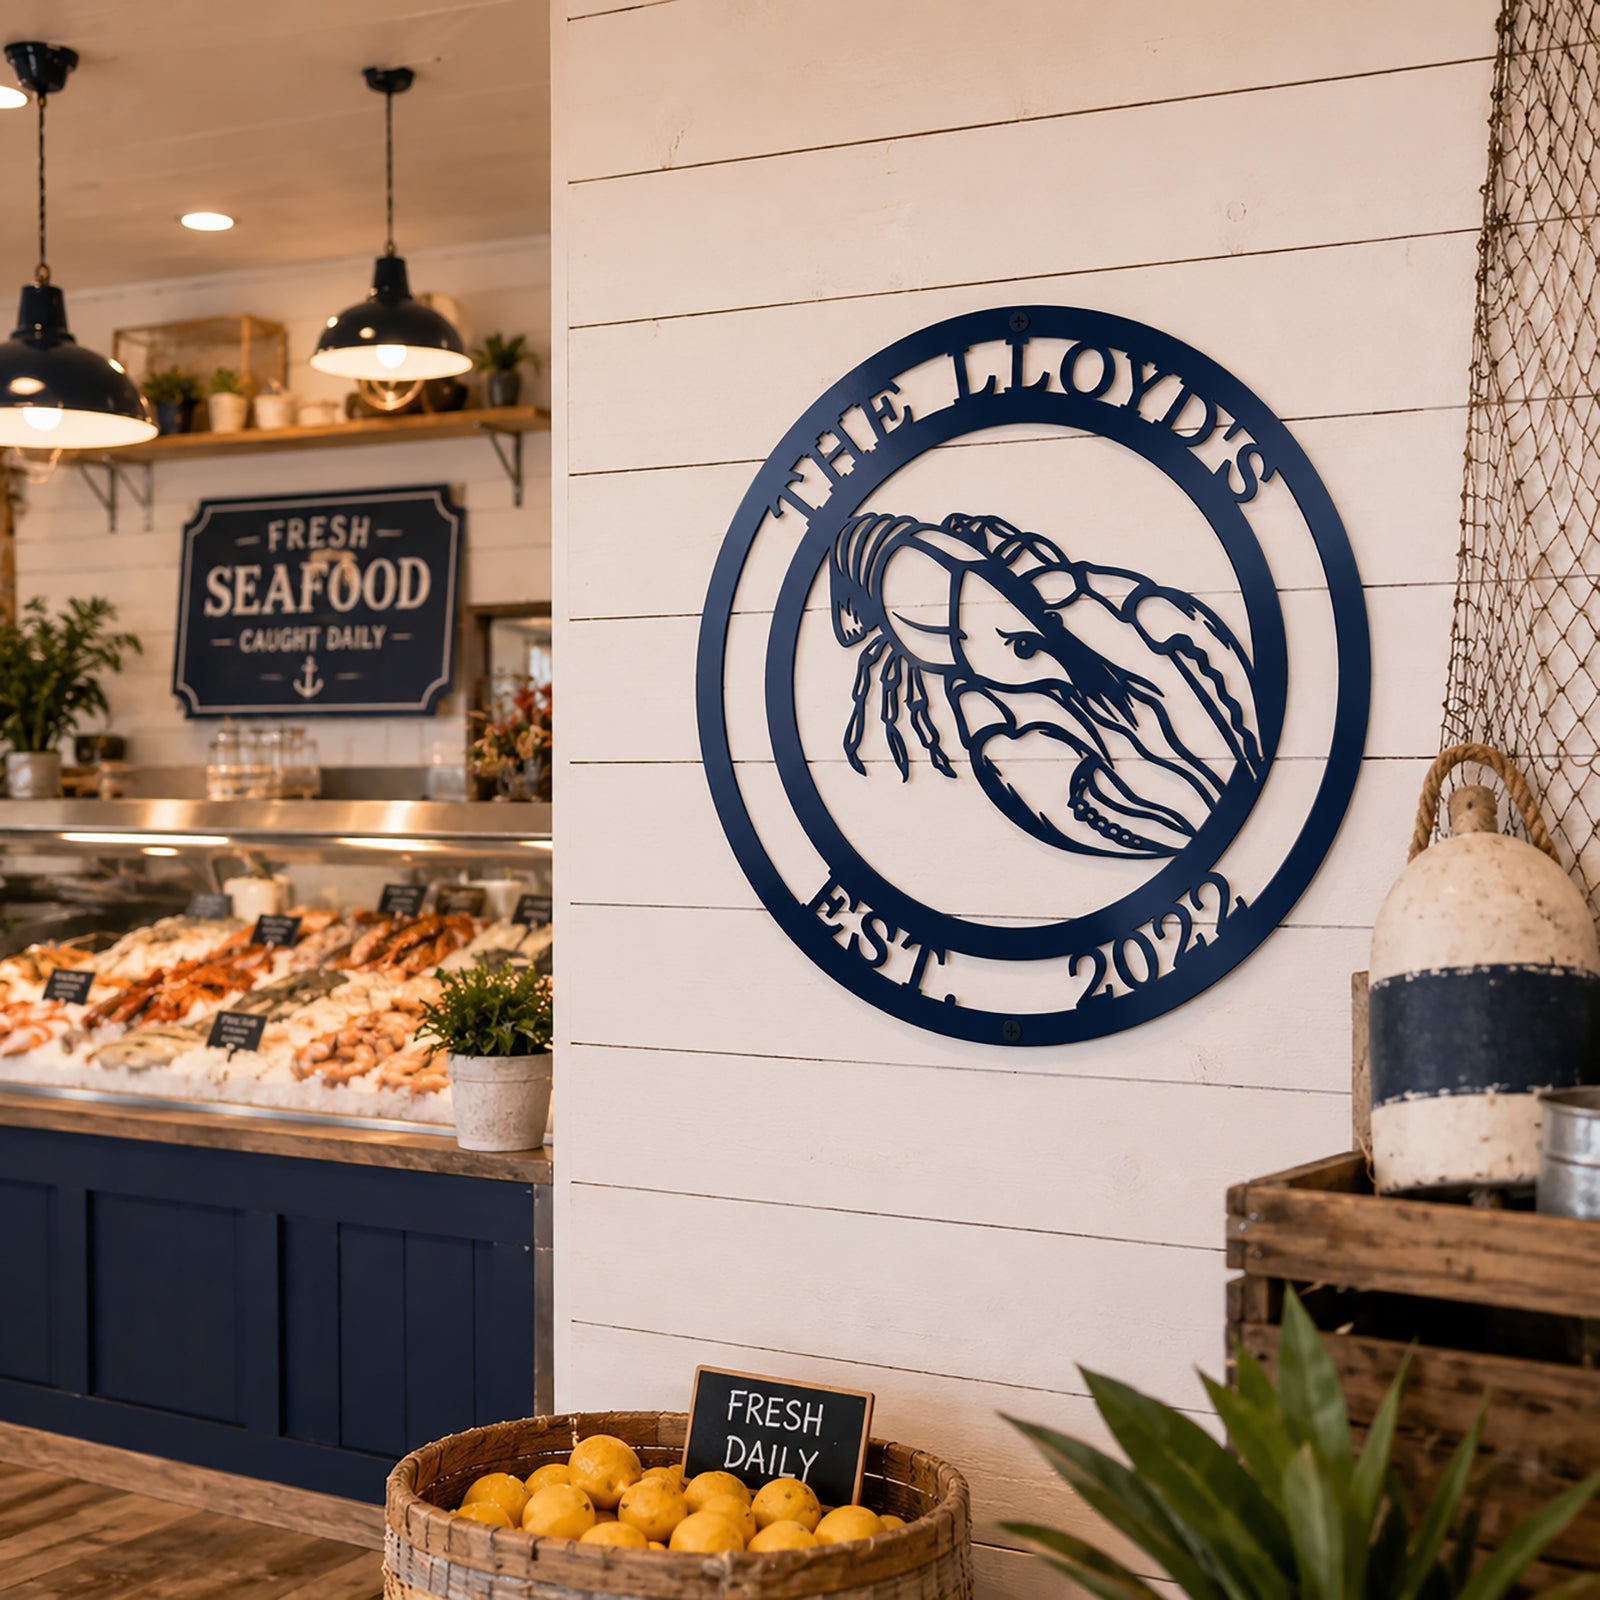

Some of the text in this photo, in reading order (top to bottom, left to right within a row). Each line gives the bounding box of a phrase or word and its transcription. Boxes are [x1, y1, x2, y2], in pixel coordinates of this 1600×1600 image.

[768, 336, 1278, 529] THE LLOYD'S
[267, 514, 371, 552] FRESH
[203, 556, 431, 617] SEAFOOD
[238, 624, 387, 653] CAUGHT DAILY
[802, 868, 1248, 1010] EST. 2022
[727, 1390, 824, 1437] FRESH
[724, 1435, 819, 1483] DAILY
